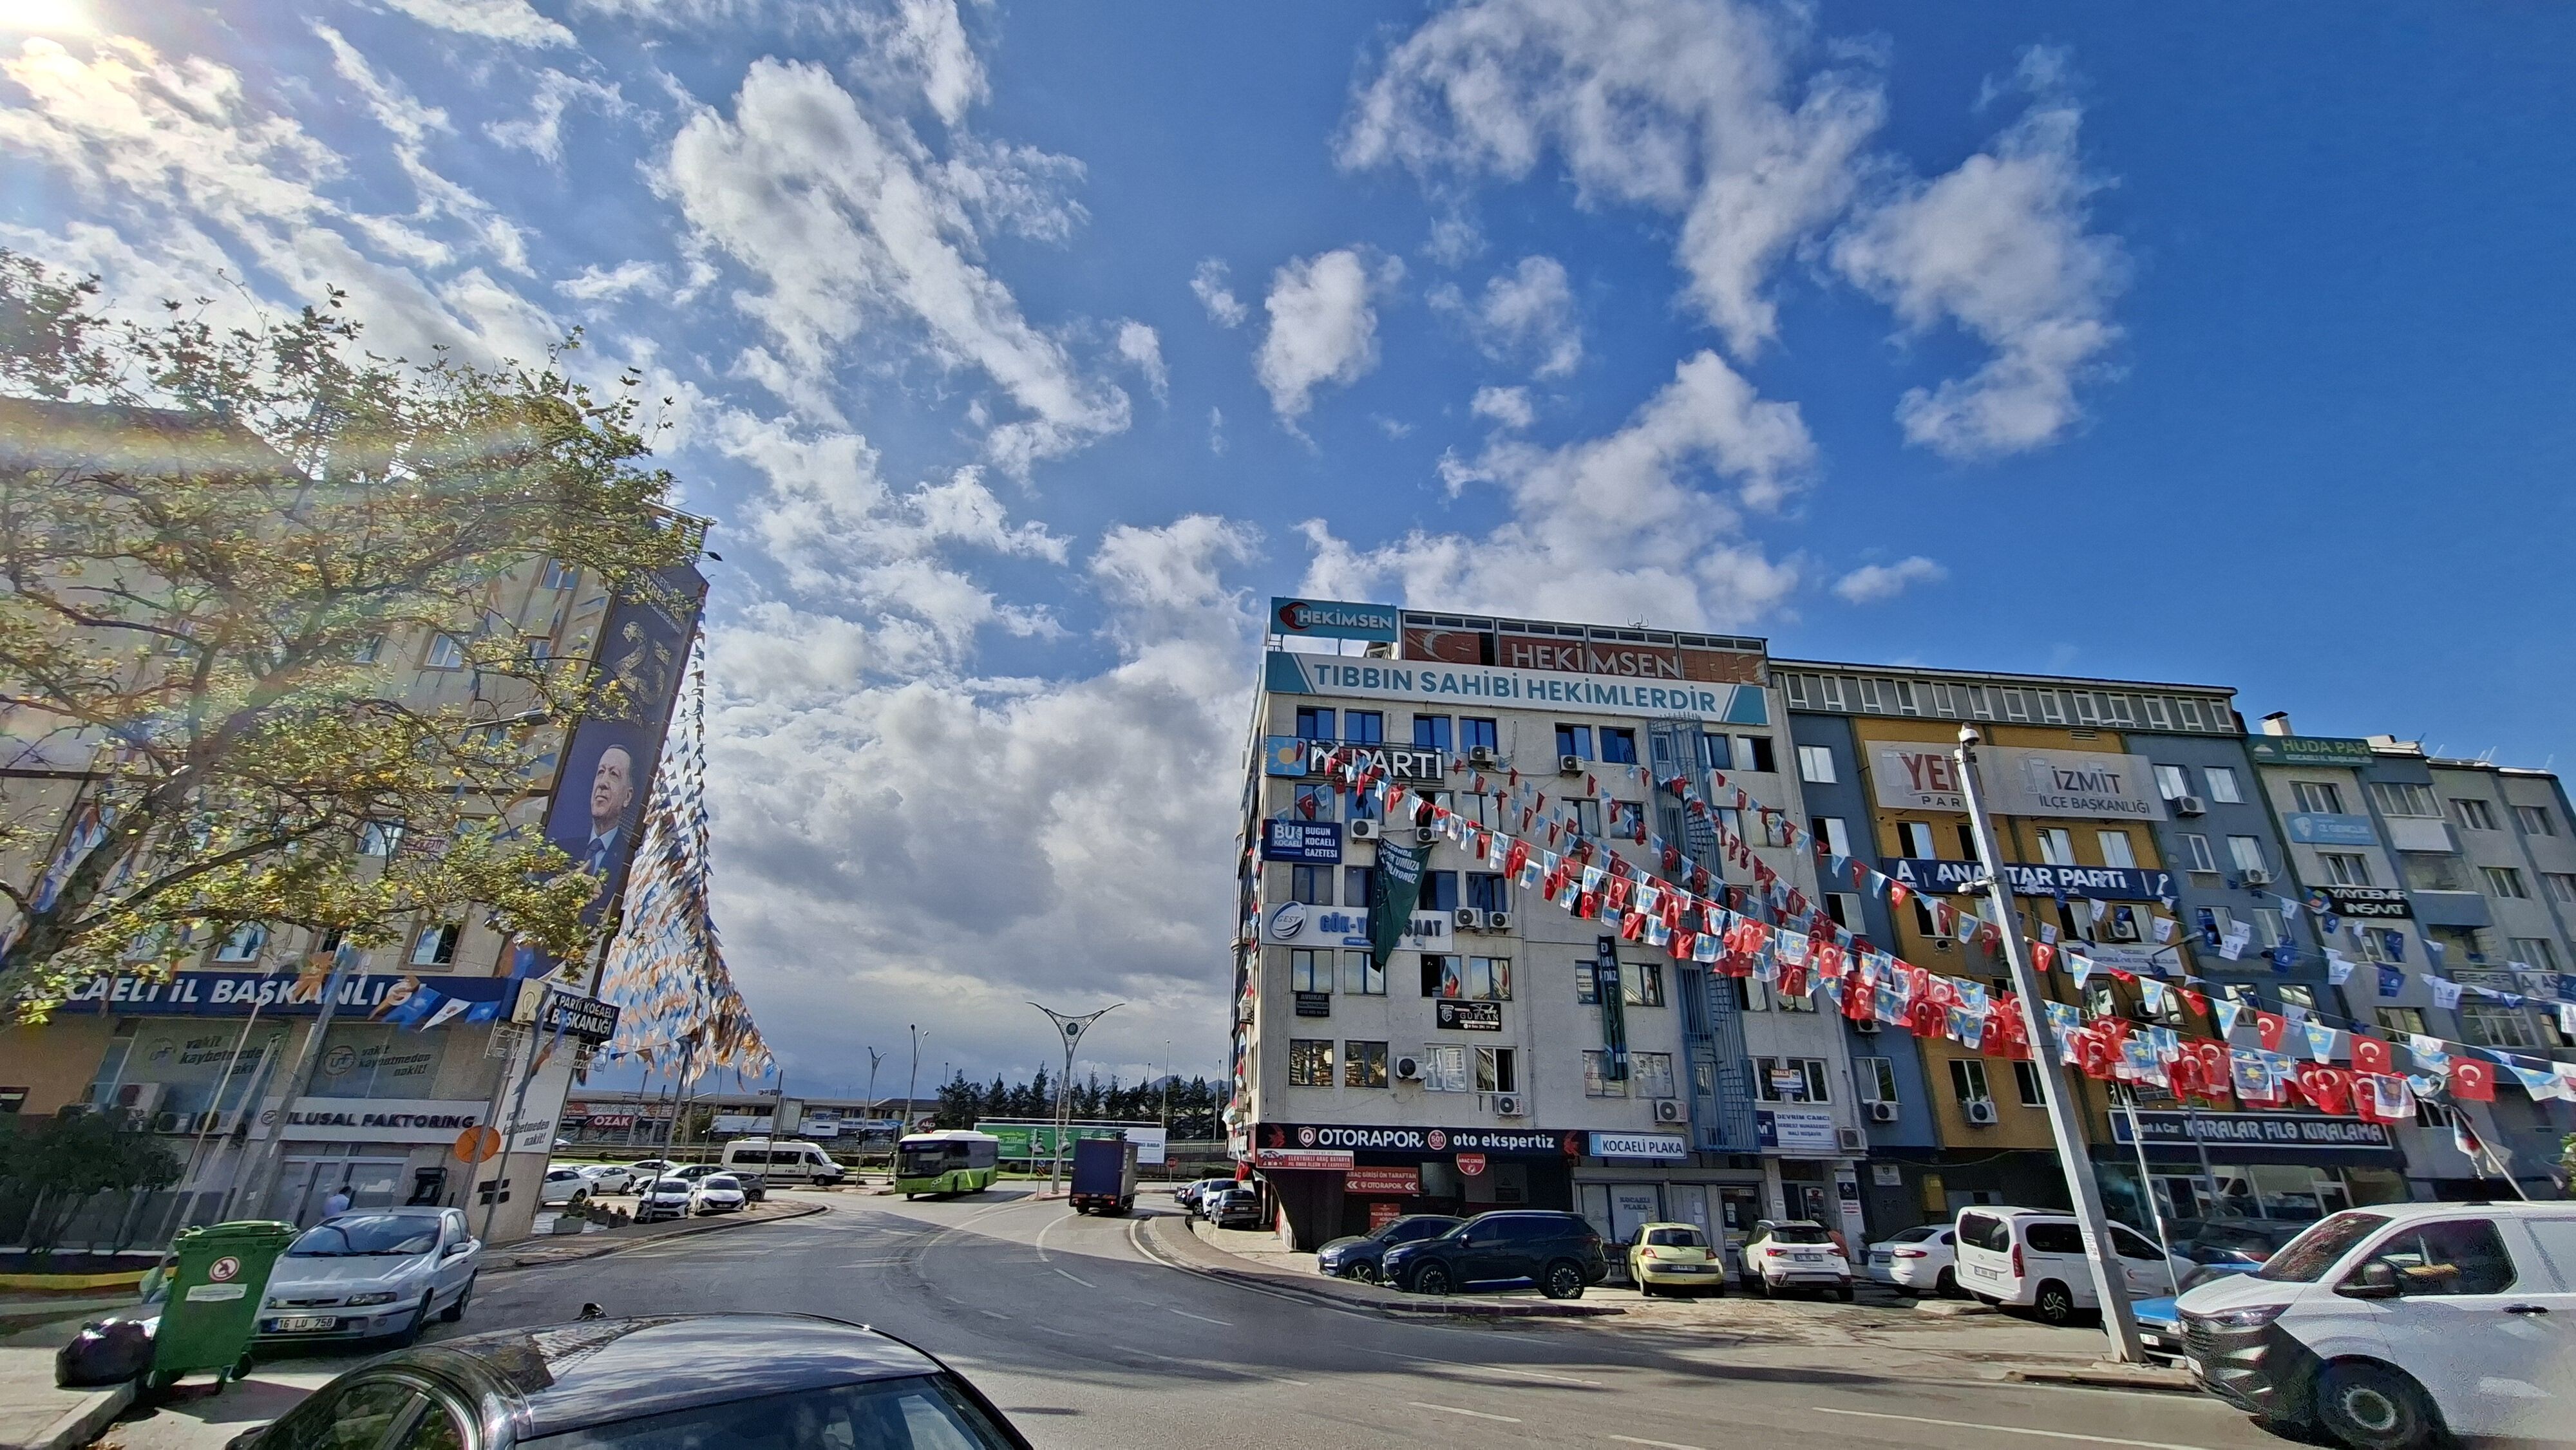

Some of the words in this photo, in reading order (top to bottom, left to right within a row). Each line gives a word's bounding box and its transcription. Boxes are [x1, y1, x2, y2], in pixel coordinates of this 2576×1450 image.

[1298, 608, 1393, 630] HEKİMSEN
[1511, 642, 1683, 680] HEKİMSEN
[1314, 664, 1412, 691] TIBBIN
[1421, 670, 1519, 699] SAHİBİ
[1527, 677, 1716, 712] HEKİMLERDİR
[2334, 742, 2371, 755] PAR
[1352, 747, 1443, 779] PARTİ
[1899, 752, 1967, 791] YEN
[2051, 765, 2121, 795] İZMİT
[2039, 794, 2069, 809] İLÇE
[2072, 796, 2151, 814] BAŞKANLIĞI
[1936, 863, 2055, 886] ANATAR
[2058, 868, 2127, 889] PARTİ
[1276, 915, 1300, 923] GEST
[209, 977, 428, 1007] BAŞKANLIĞ
[550, 1008, 613, 1036] BŞKANLIĞI
[501, 1118, 551, 1136] kabetmeden
[1318, 1128, 1424, 1148] OTORAPOR
[1430, 1135, 1444, 1144] 501
[1452, 1133, 1477, 1147] oto
[1481, 1132, 1555, 1151] ekspertiz
[1602, 1138, 1646, 1153] KOCAELİ
[1649, 1142, 1683, 1154] PLAKA
[278, 1319, 289, 1328] 16
